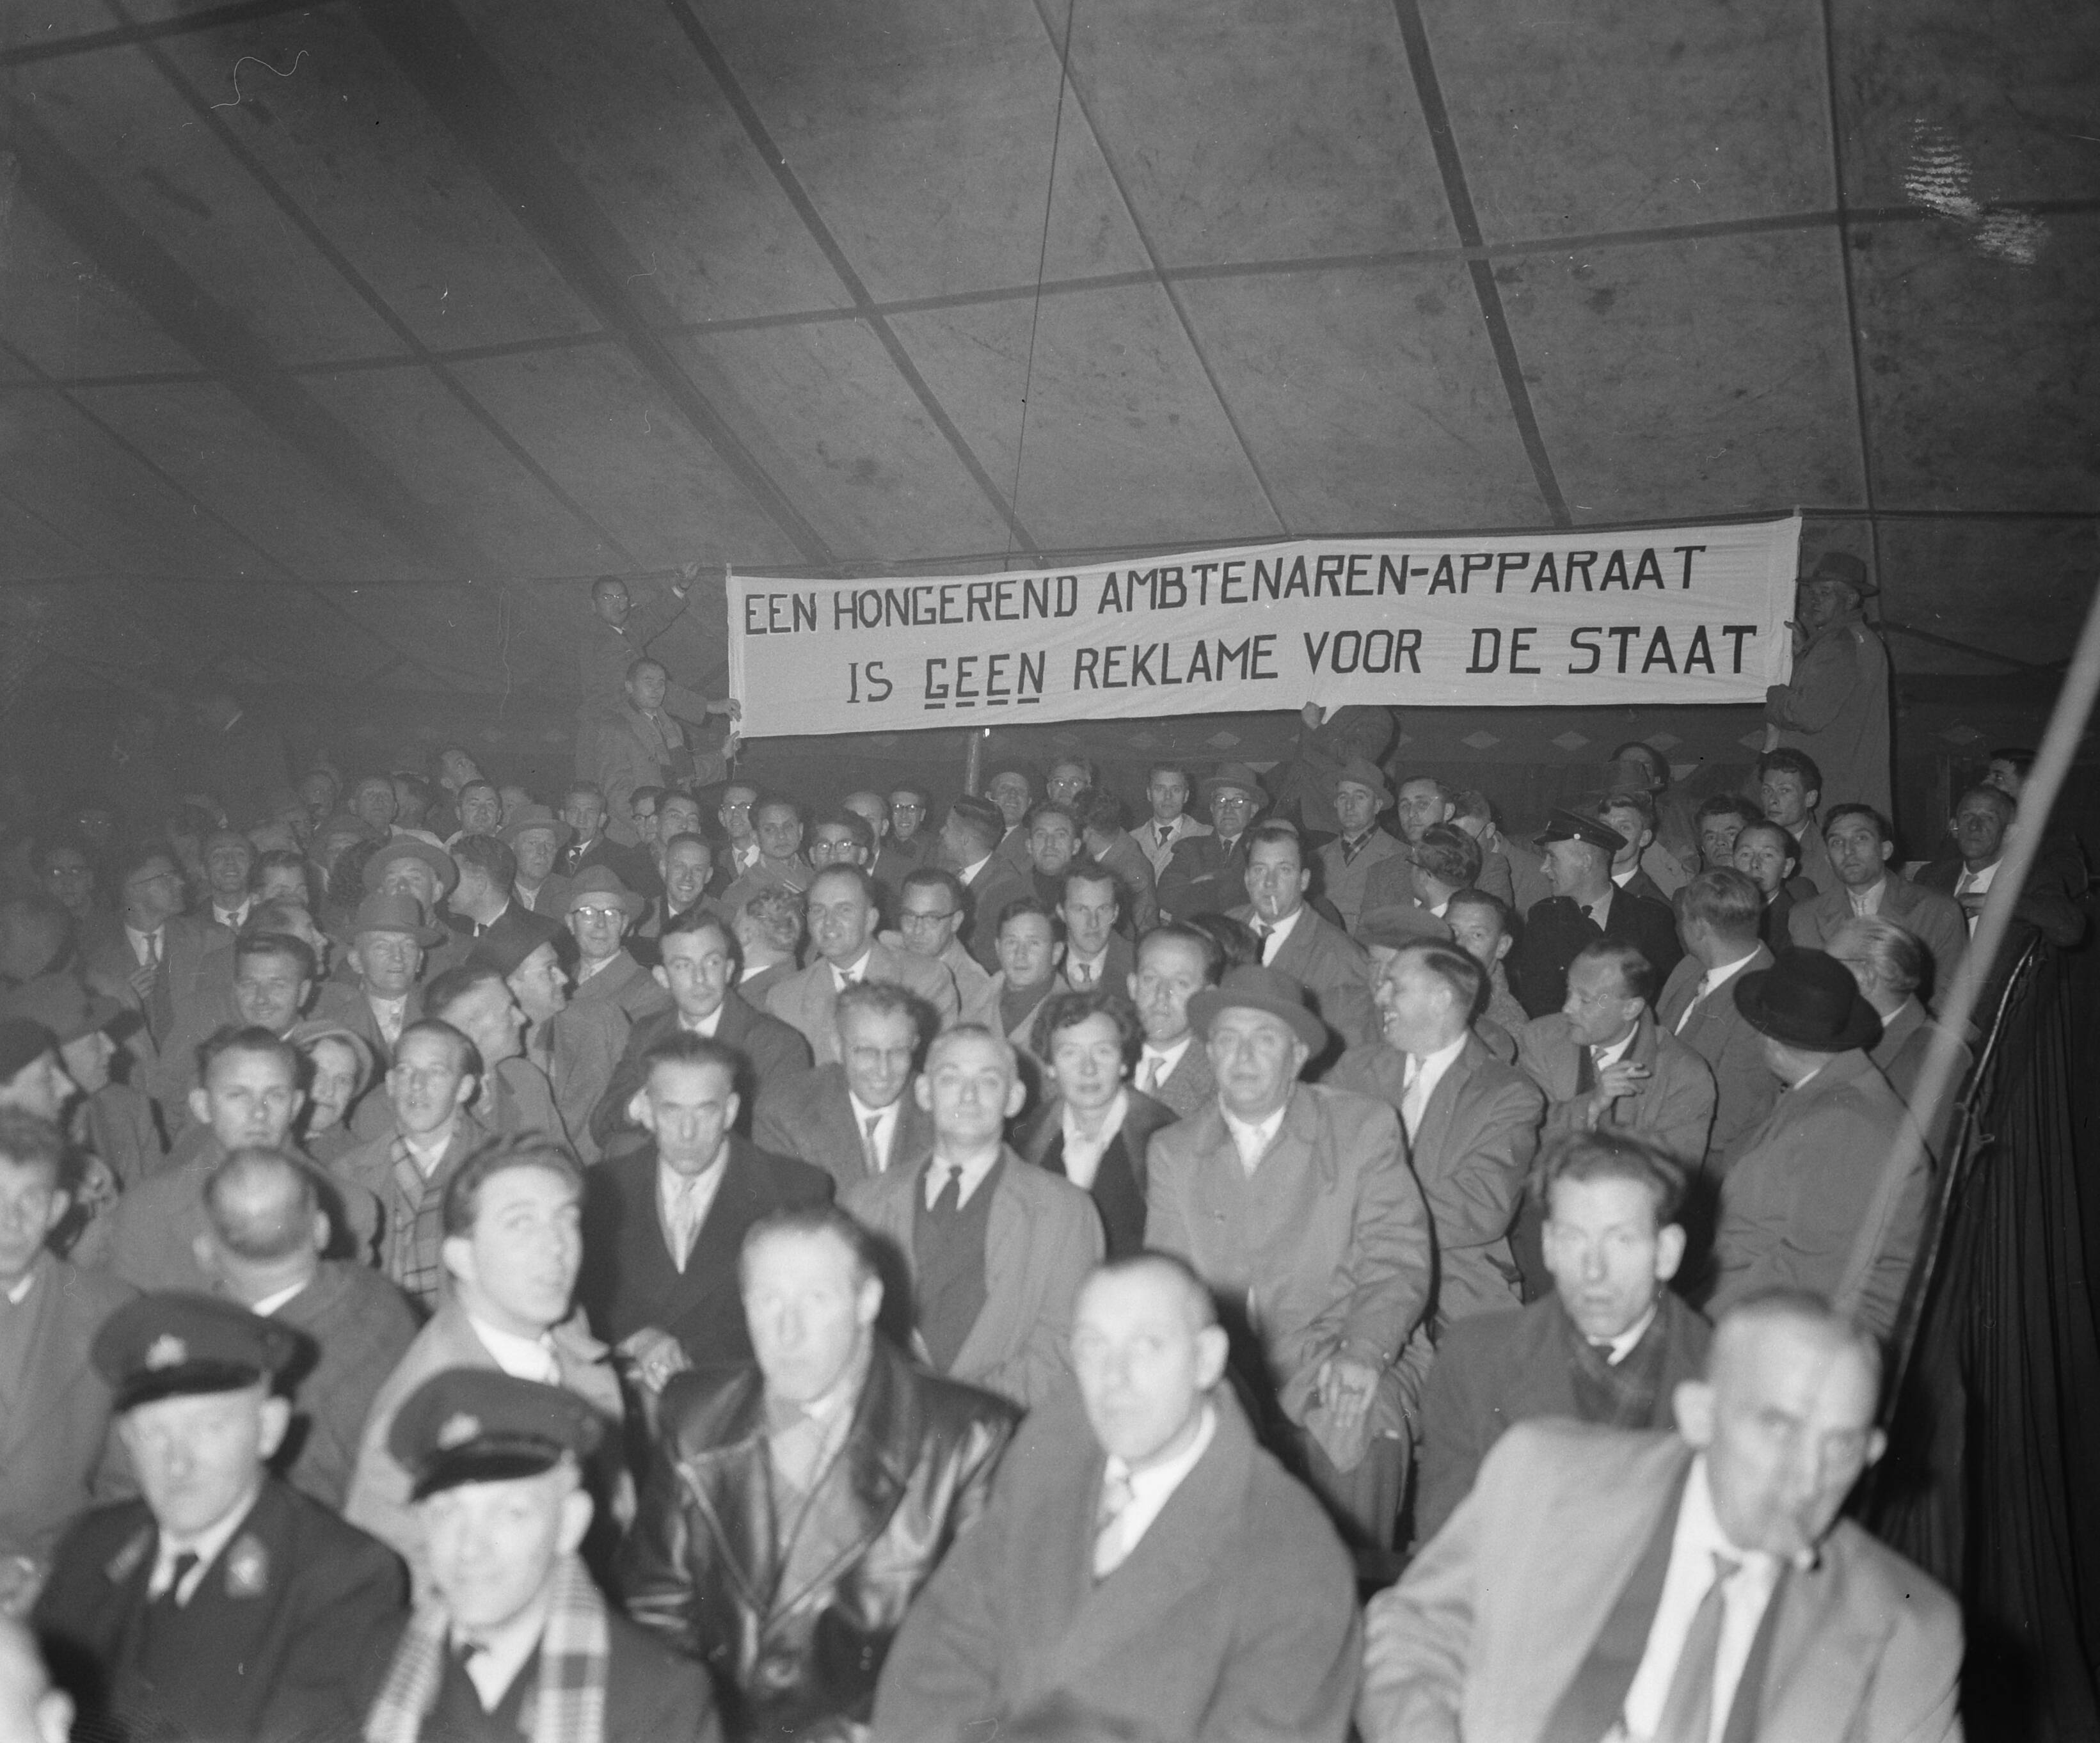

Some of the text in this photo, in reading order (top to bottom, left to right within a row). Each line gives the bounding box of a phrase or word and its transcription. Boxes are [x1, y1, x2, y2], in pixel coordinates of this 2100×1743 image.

[745, 545, 1707, 635] EEN HONGEREND AMBTENAREN-APPARAAT
[846, 625, 1758, 703] IS GEEN REKLAME VOOR DE STAAT
